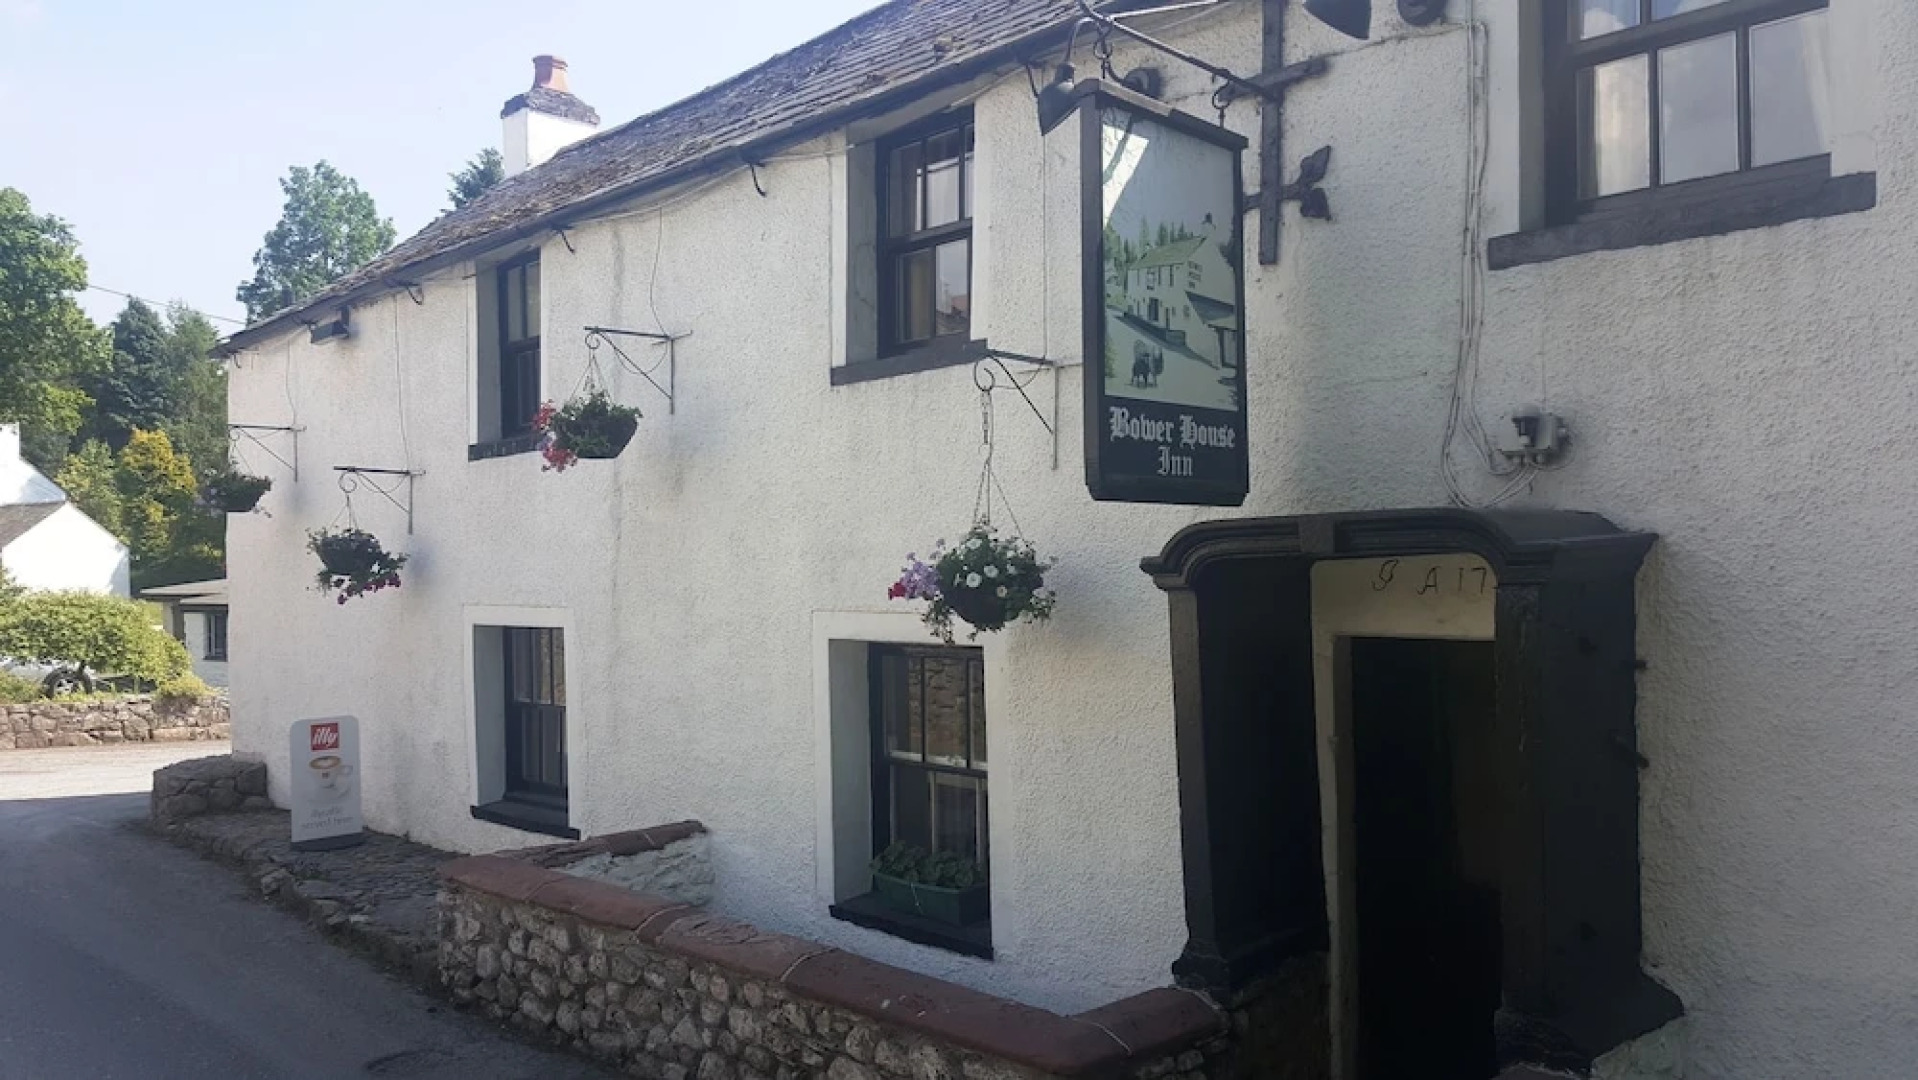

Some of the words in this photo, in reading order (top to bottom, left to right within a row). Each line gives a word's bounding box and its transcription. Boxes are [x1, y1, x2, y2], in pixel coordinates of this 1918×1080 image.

[1109, 406, 1174, 441] Bower
[1180, 414, 1235, 449] House
[1157, 446, 1193, 476] Inn
[313, 727, 338, 748] illy
